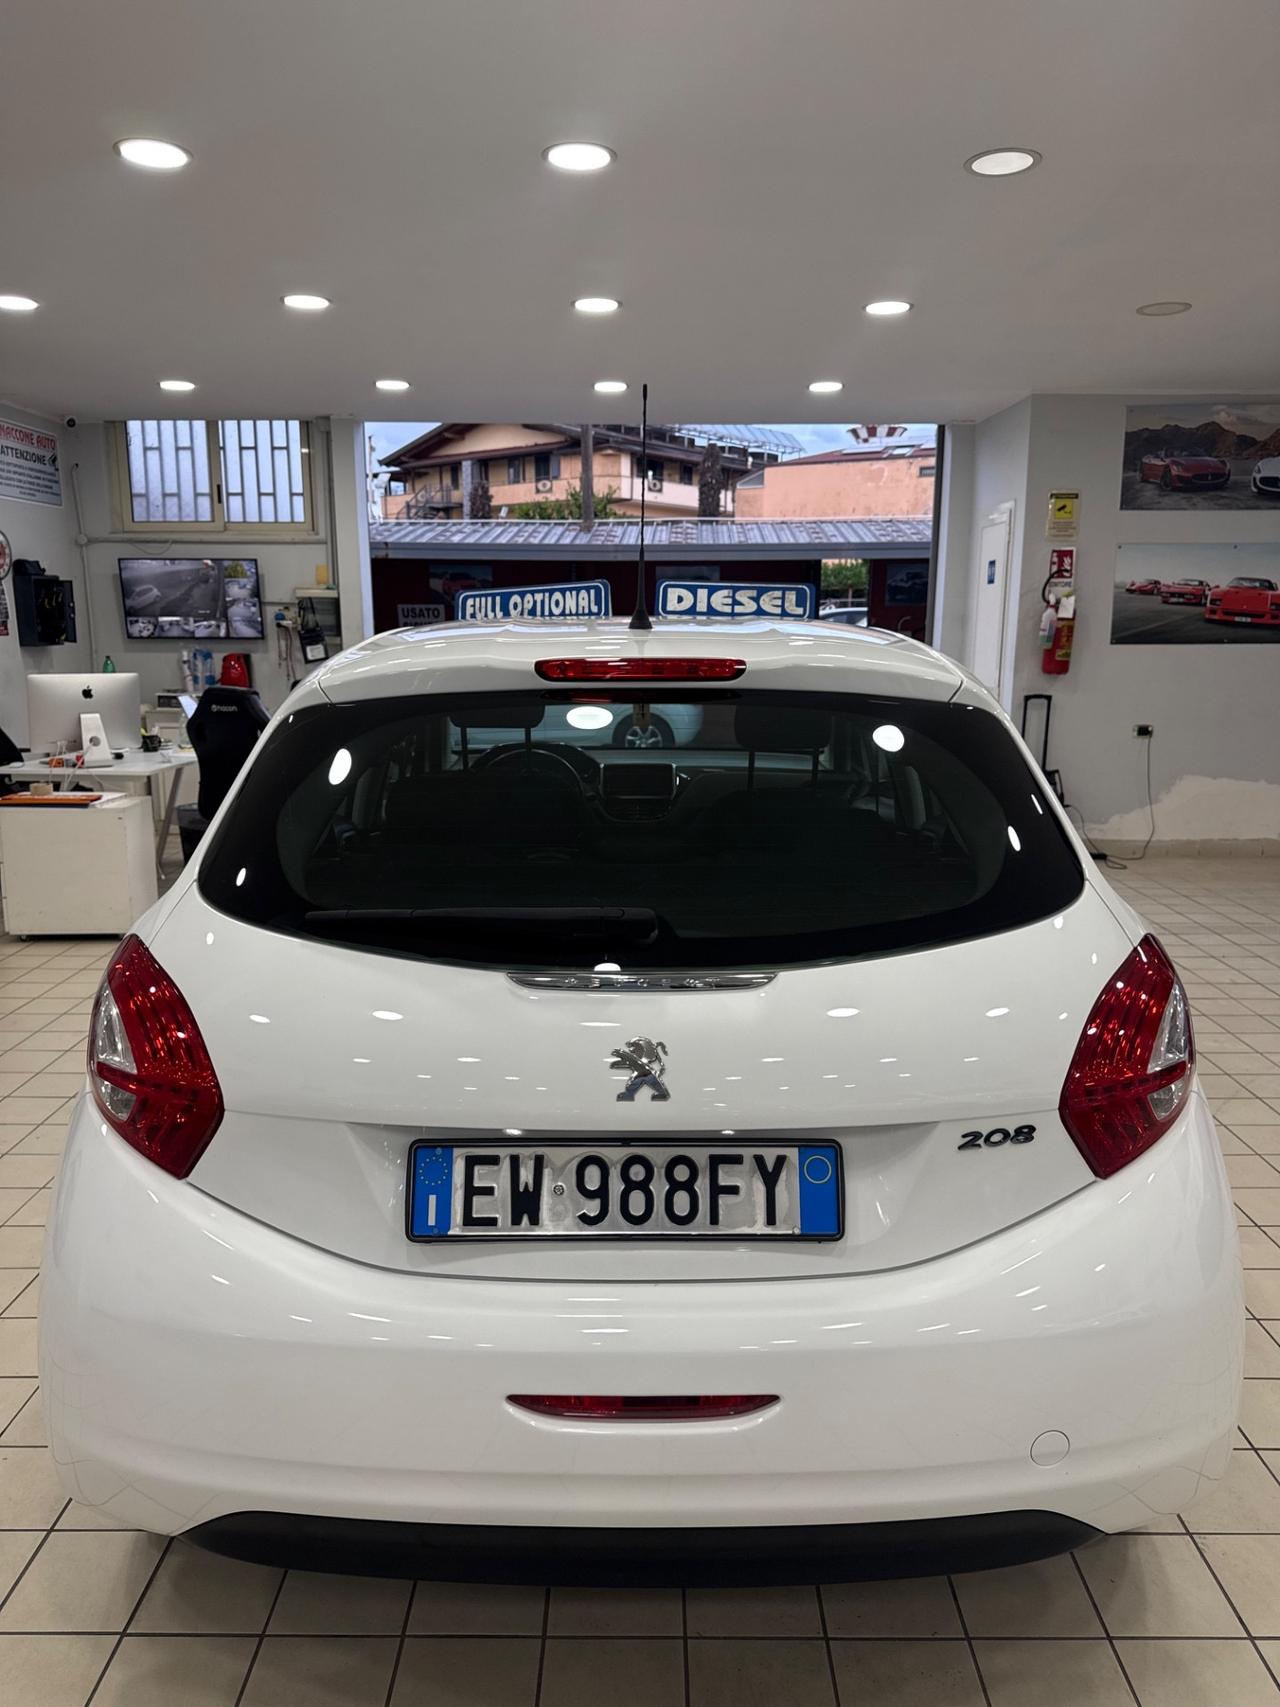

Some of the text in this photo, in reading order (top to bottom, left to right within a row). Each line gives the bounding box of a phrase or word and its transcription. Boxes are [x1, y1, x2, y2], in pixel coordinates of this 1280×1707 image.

[0, 444, 47, 465] ATTENZIONE
[36, 434, 56, 451] AUTO
[401, 607, 440, 619] USATO
[465, 590, 599, 620] FULL OPTIONAL
[666, 588, 804, 615] DIESEL
[957, 1124, 1036, 1151] 208
[462, 1154, 544, 1227] EW
